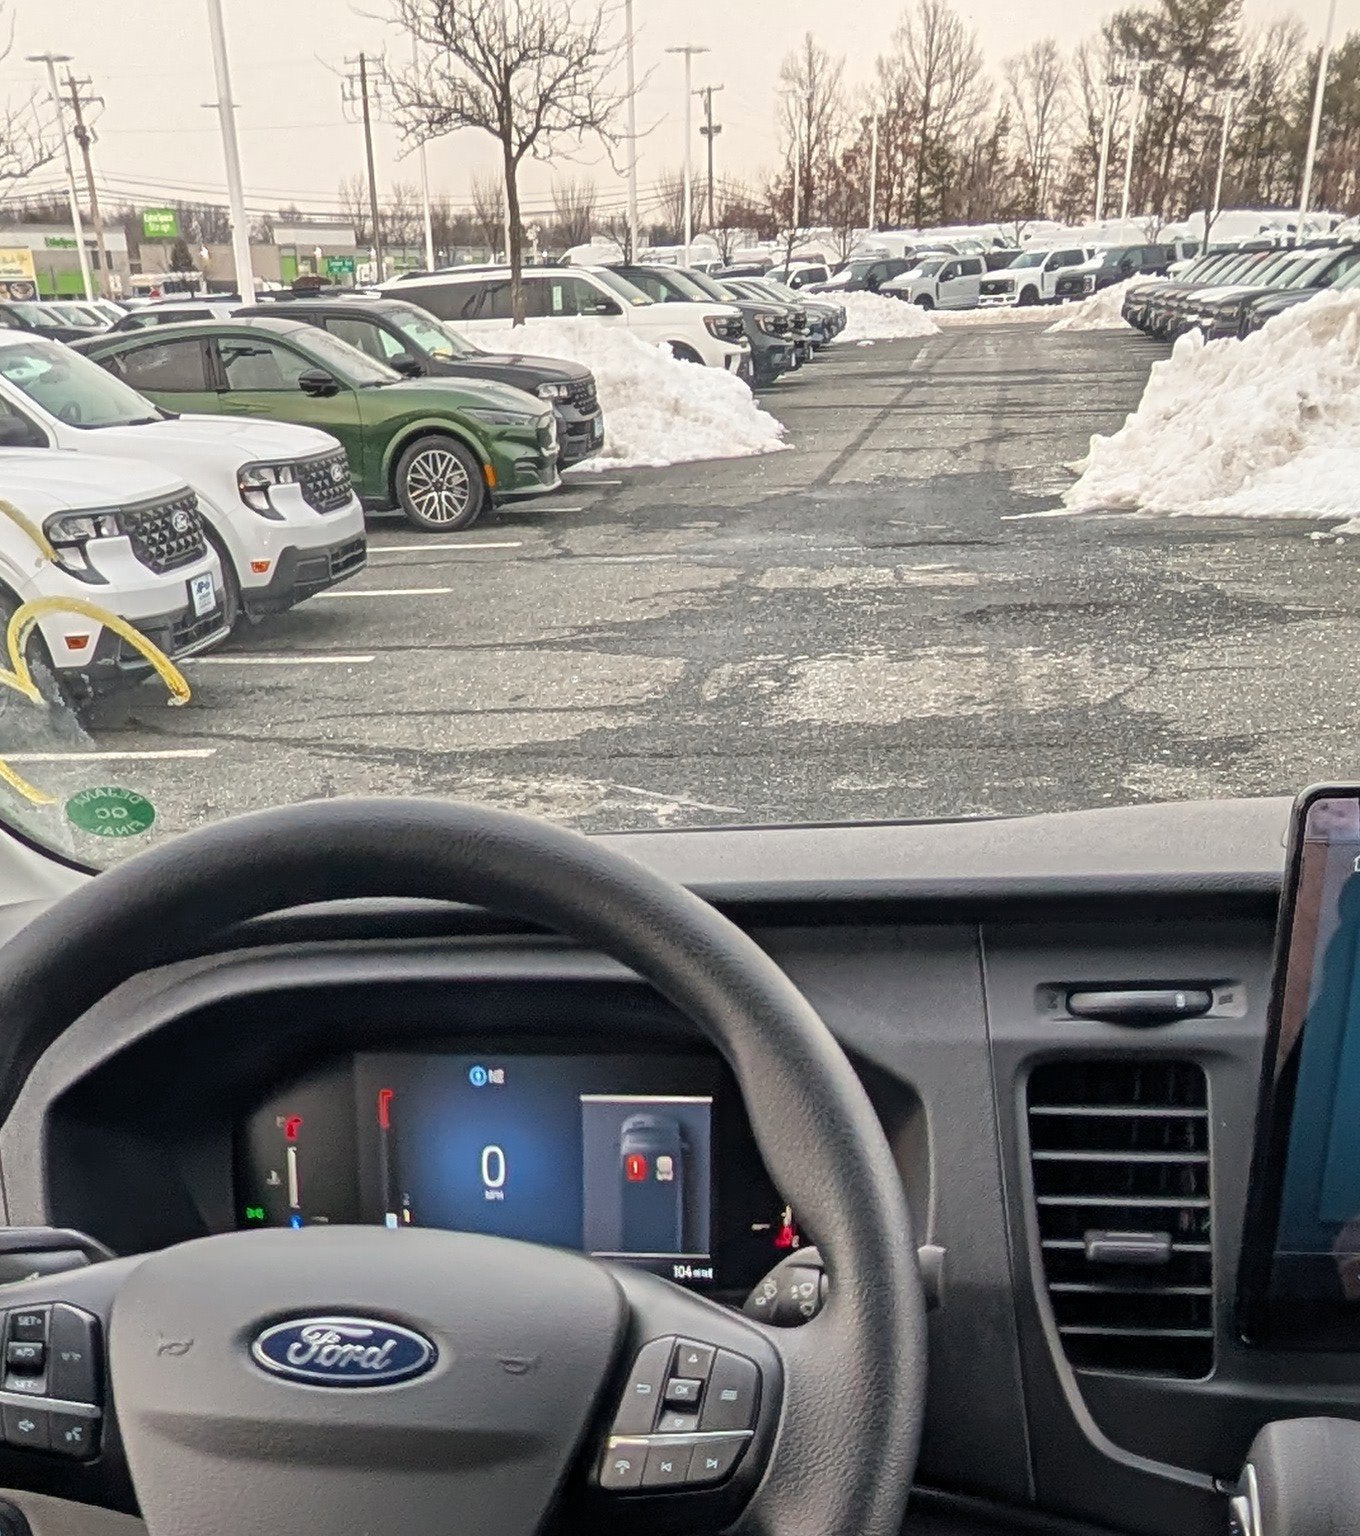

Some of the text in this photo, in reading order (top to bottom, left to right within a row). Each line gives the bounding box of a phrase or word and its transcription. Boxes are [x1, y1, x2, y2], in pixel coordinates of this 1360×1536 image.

[481, 1144, 506, 1188] 0
[673, 1264, 692, 1279] 104
[286, 1324, 398, 1370] Ford
